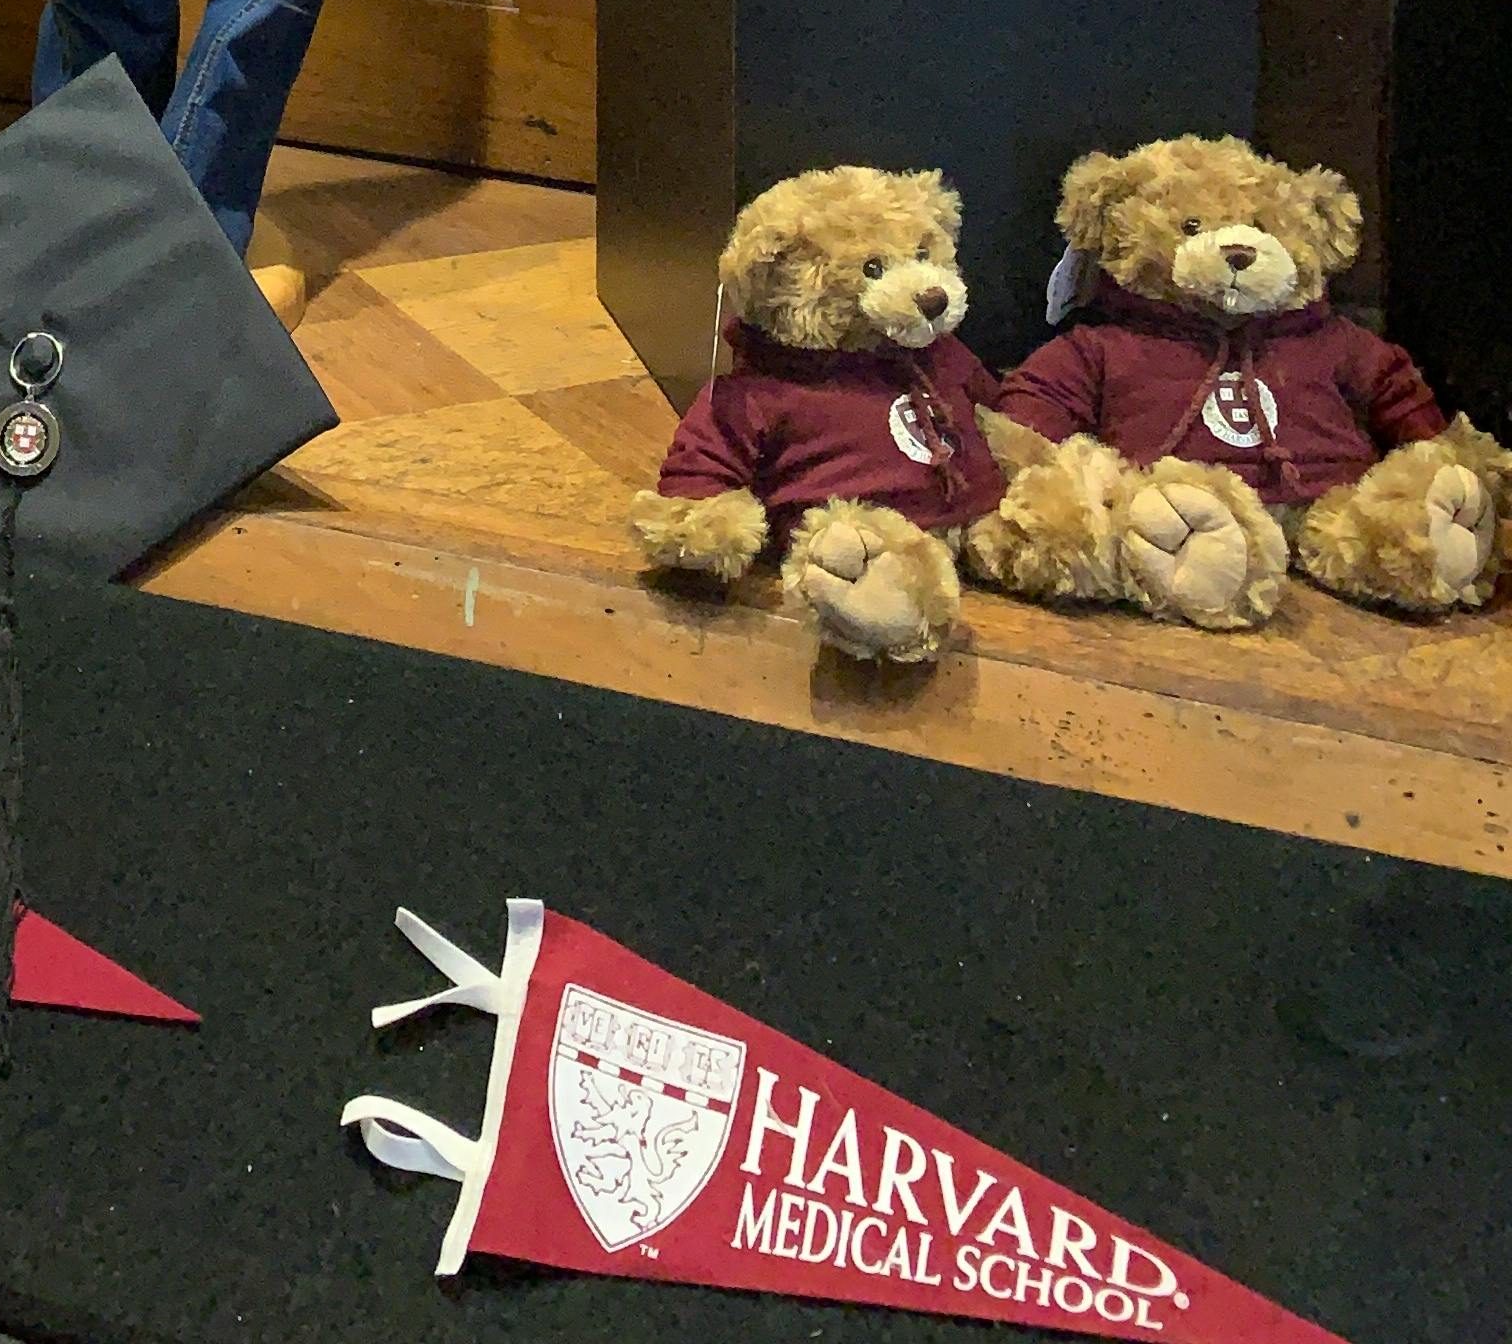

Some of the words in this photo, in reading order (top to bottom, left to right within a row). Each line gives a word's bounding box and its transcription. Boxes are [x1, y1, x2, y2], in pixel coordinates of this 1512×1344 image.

[731, 1183, 942, 1288] MEDICAL
[953, 1251, 1165, 1331] SCHOOL
[739, 1066, 1176, 1300] HARVARD
